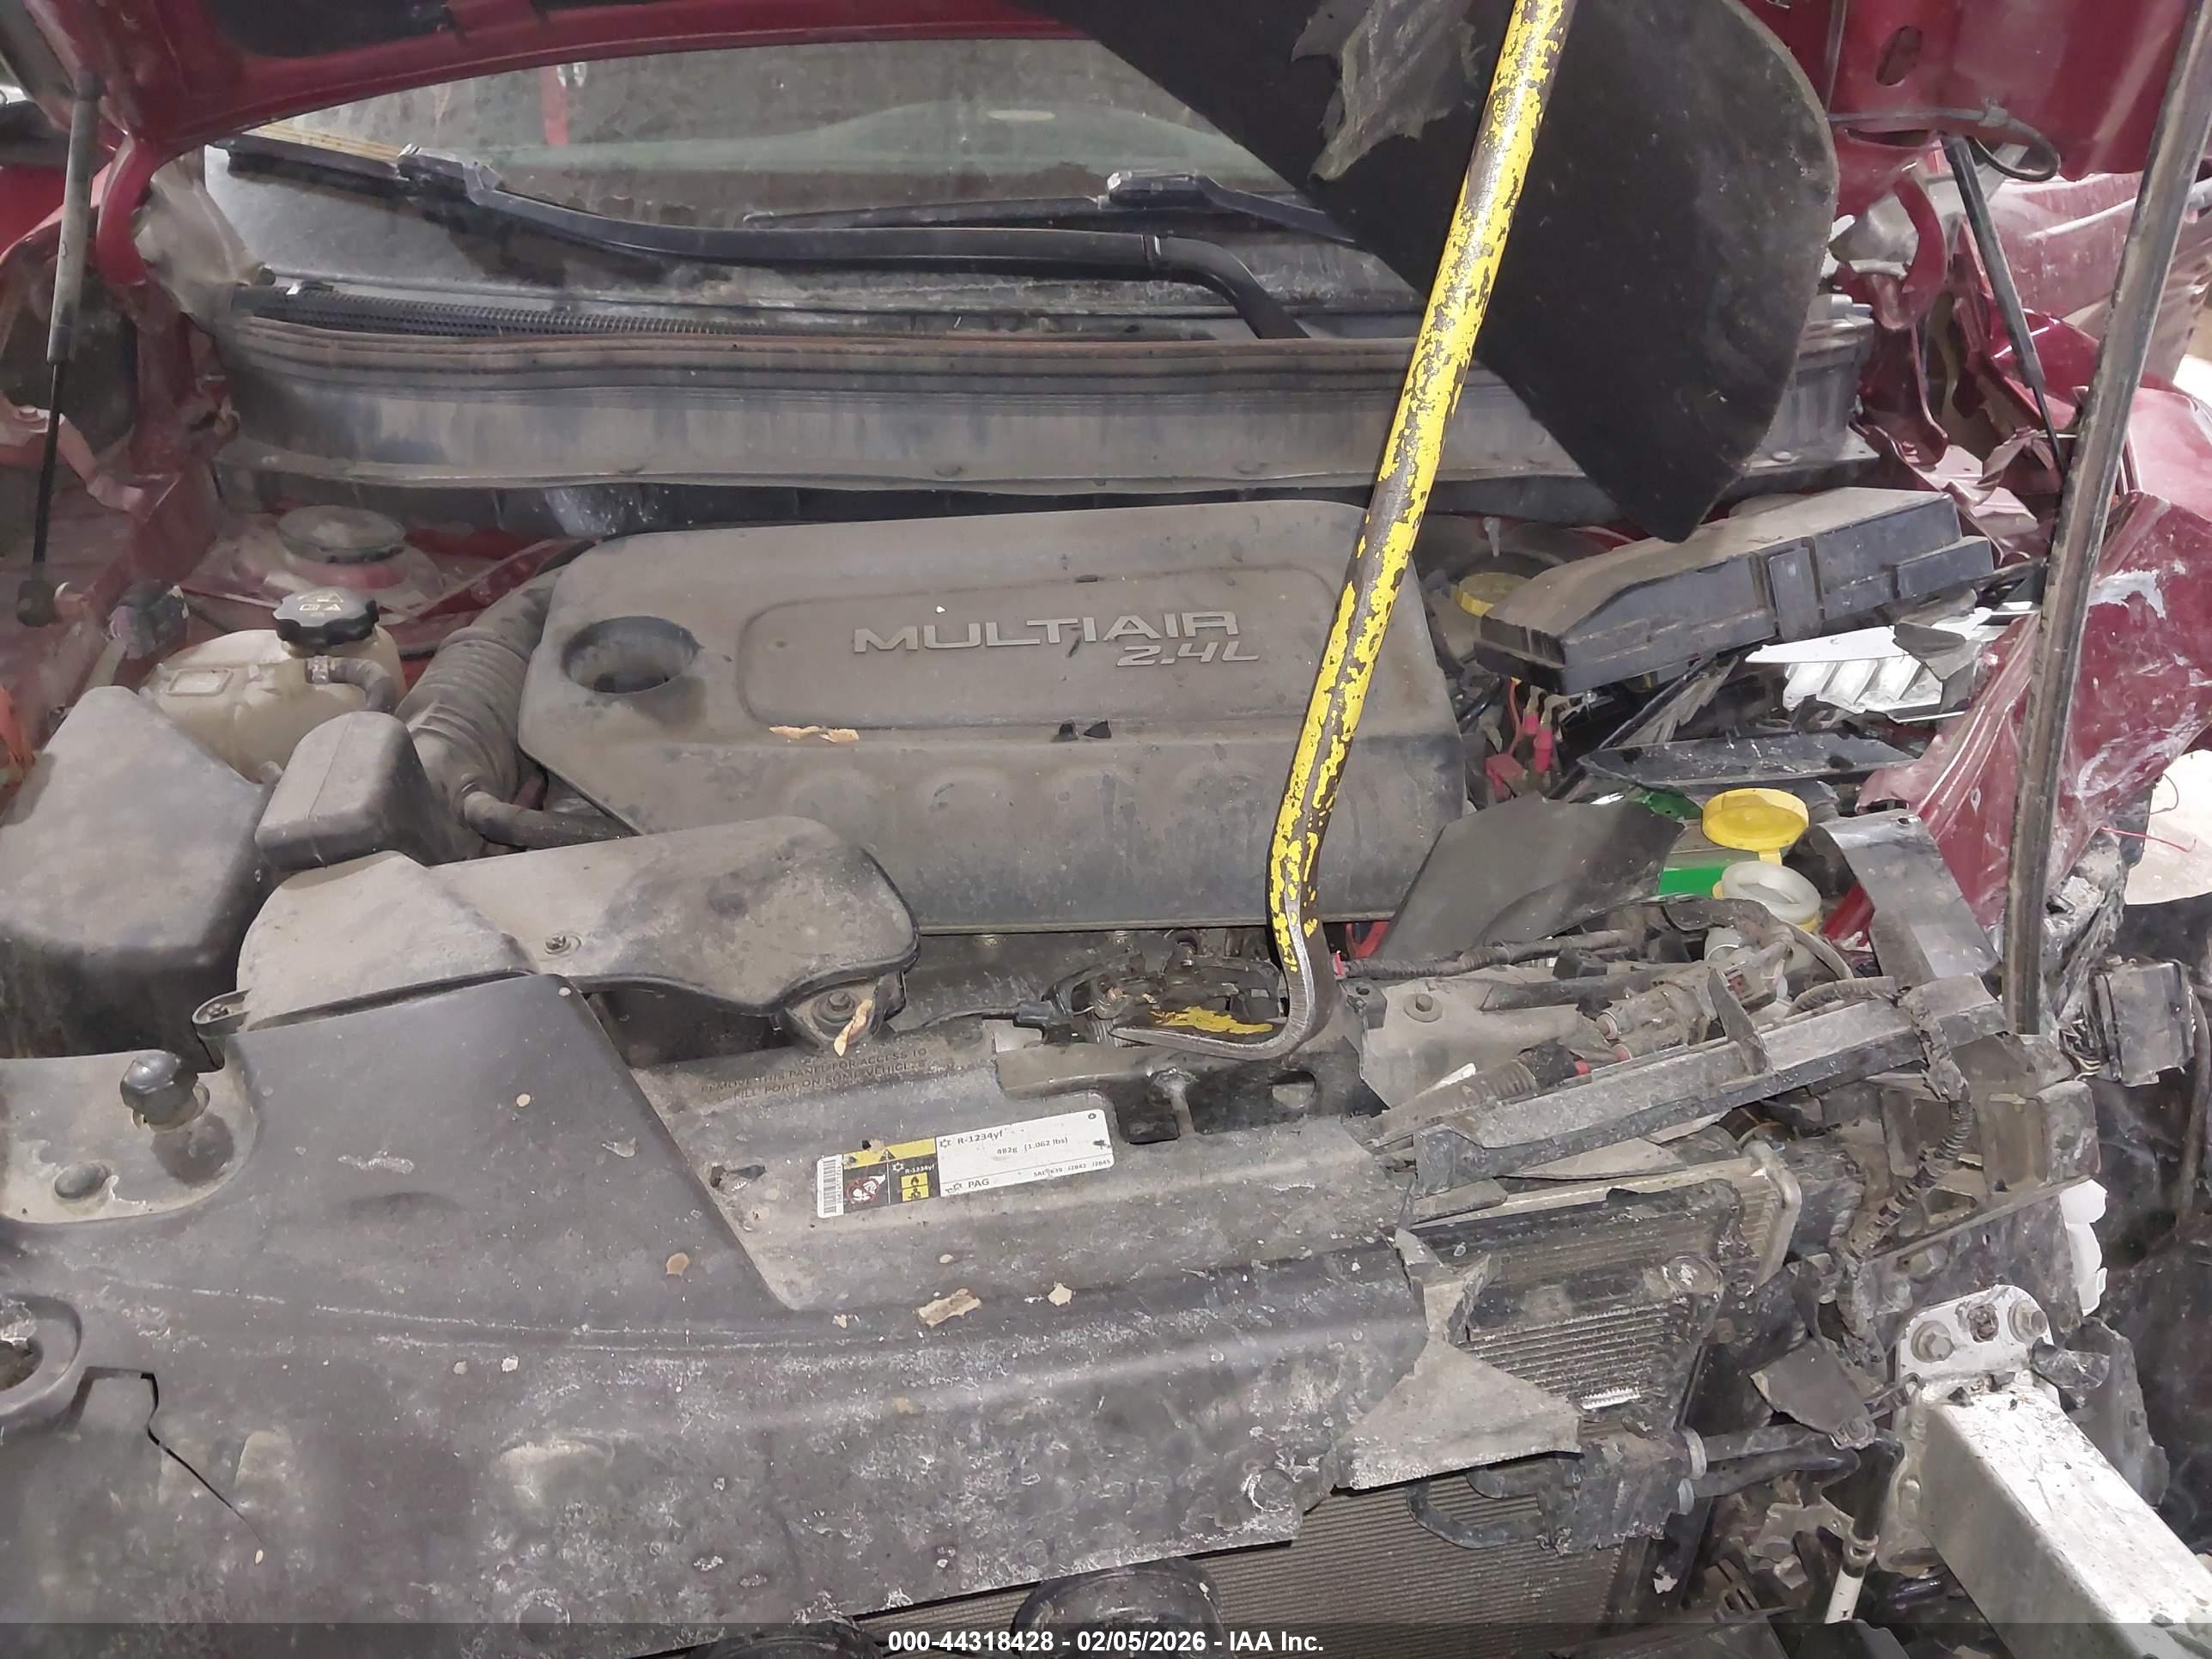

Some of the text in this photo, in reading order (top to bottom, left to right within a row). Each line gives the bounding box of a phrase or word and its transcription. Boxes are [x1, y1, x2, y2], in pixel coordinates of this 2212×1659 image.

[853, 611, 1239, 653] MULTIAIR
[1116, 640, 1260, 666] 2.4L
[831, 1059, 856, 1073] FOR
[860, 1051, 908, 1066] ACCESS
[913, 1047, 927, 1057] TO
[802, 1078, 821, 1087] ON
[957, 1129, 1004, 1146] R-1234yf
[967, 1178, 990, 1189] PAG
